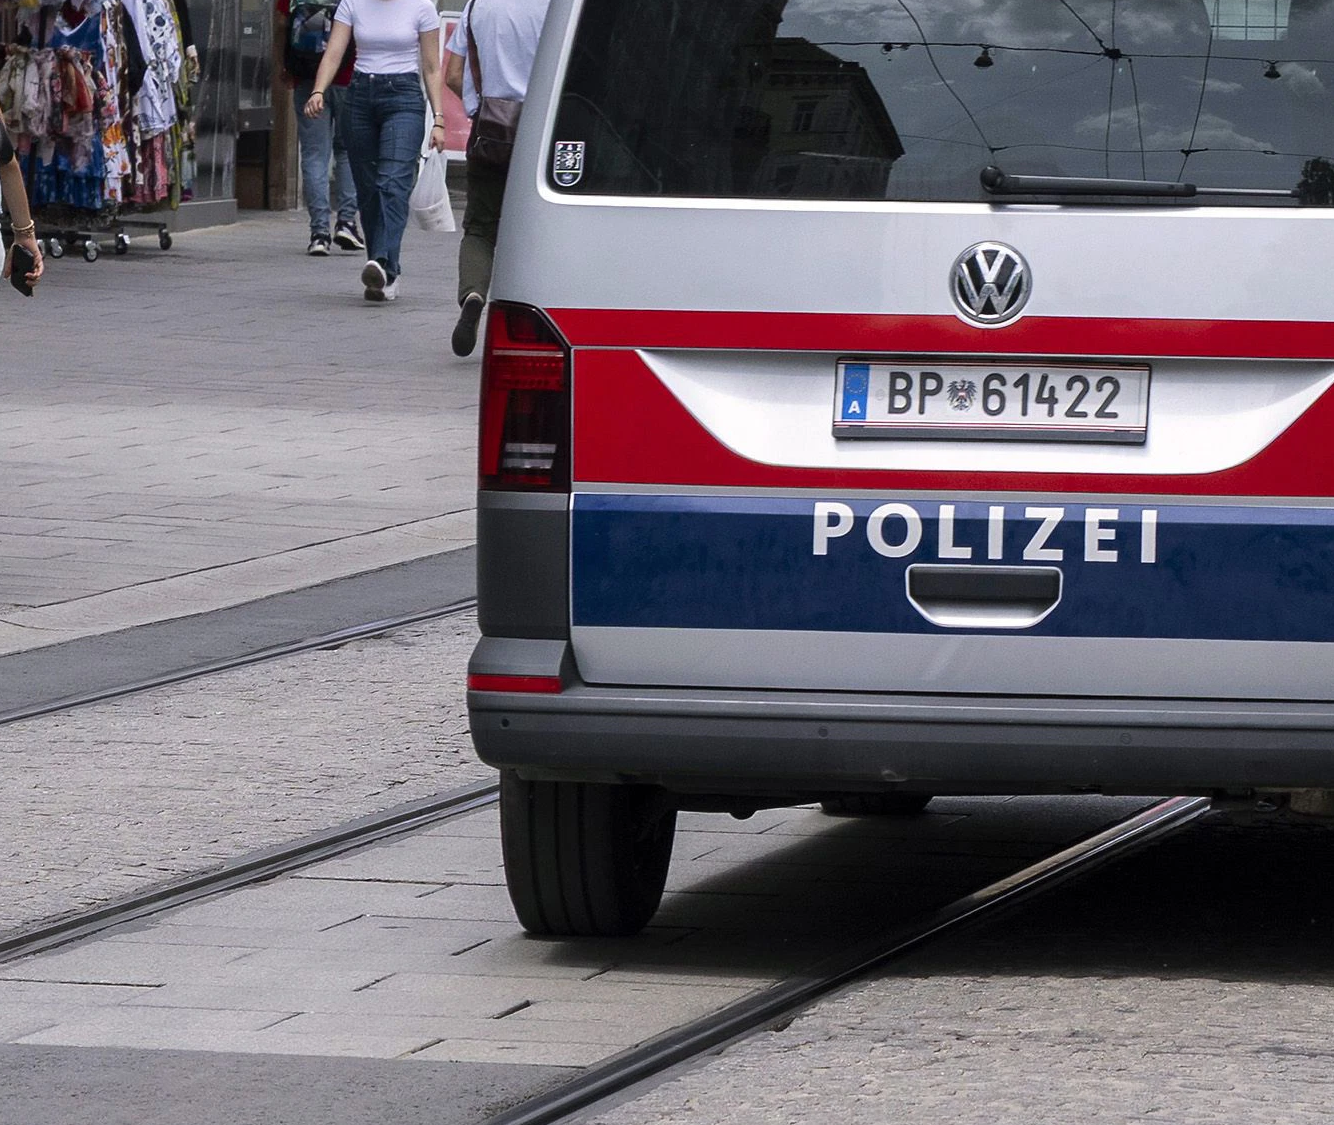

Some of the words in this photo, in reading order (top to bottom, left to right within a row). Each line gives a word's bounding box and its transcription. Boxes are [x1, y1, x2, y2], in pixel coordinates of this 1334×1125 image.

[848, 400, 861, 414] A
[887, 371, 944, 415] BP
[981, 372, 1122, 419] 61422
[813, 501, 1159, 564] POLIZEI
